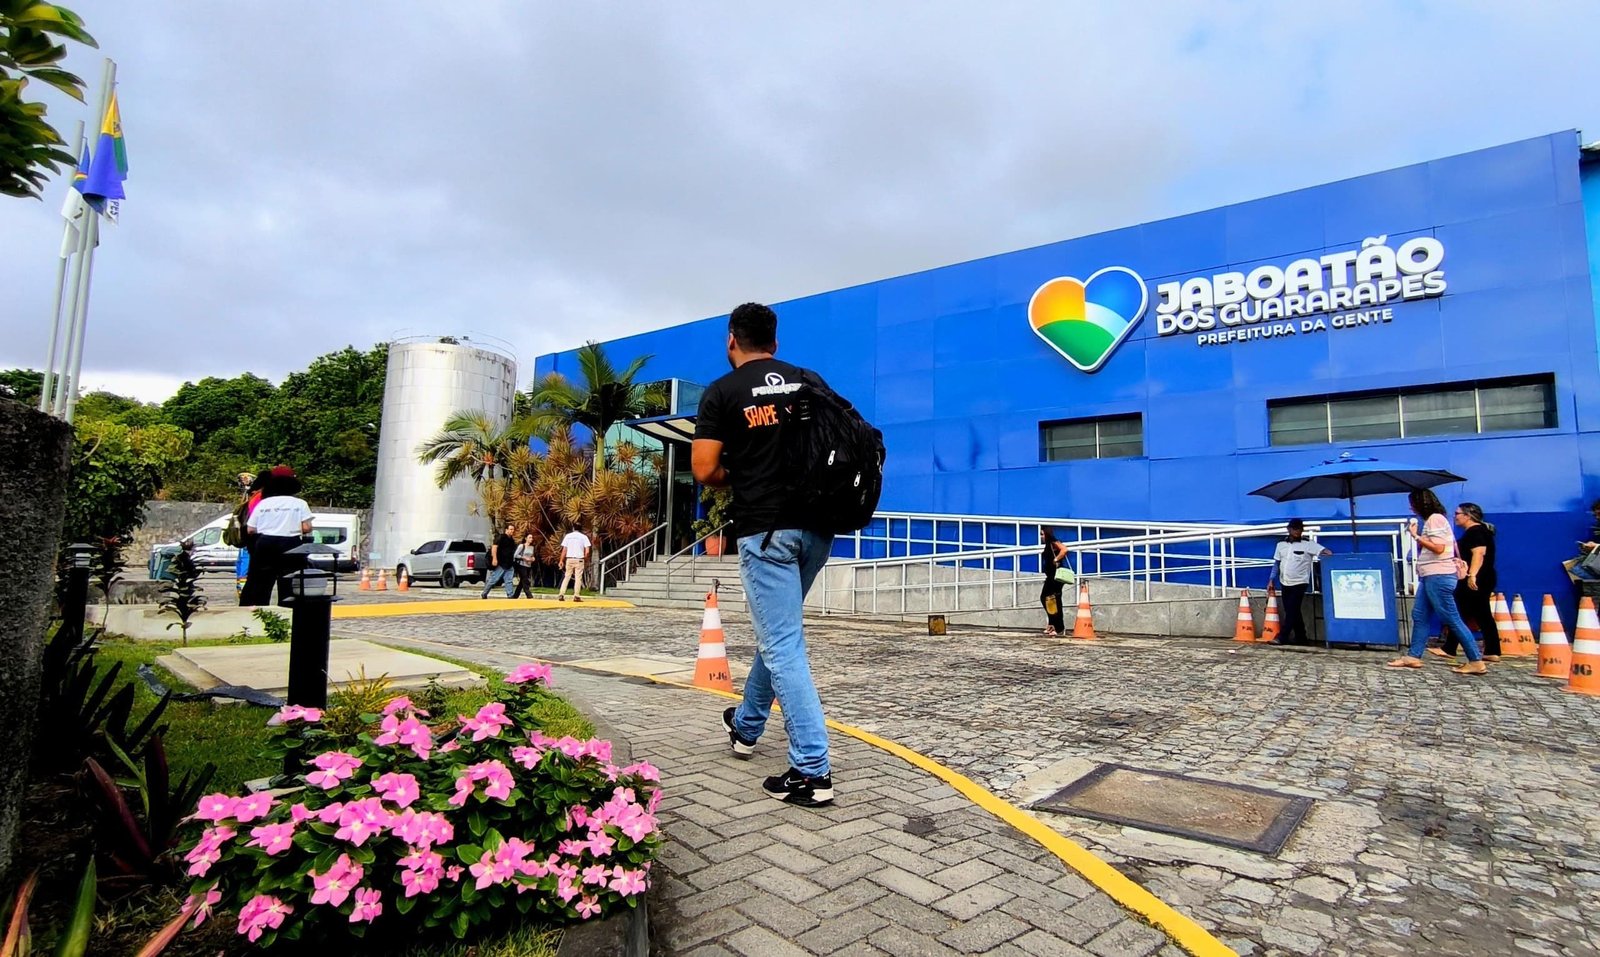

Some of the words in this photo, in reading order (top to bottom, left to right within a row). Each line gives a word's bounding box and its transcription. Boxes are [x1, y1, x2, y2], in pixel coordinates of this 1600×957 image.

[1156, 234, 1445, 314] JABOATÃO
[1156, 306, 1216, 334] DOS
[1219, 270, 1447, 326] GUARARAPES
[1197, 322, 1296, 346] PREFEITURA
[1301, 318, 1326, 333] DA
[1332, 307, 1393, 328] GENTE
[743, 404, 778, 428] SHAPE
